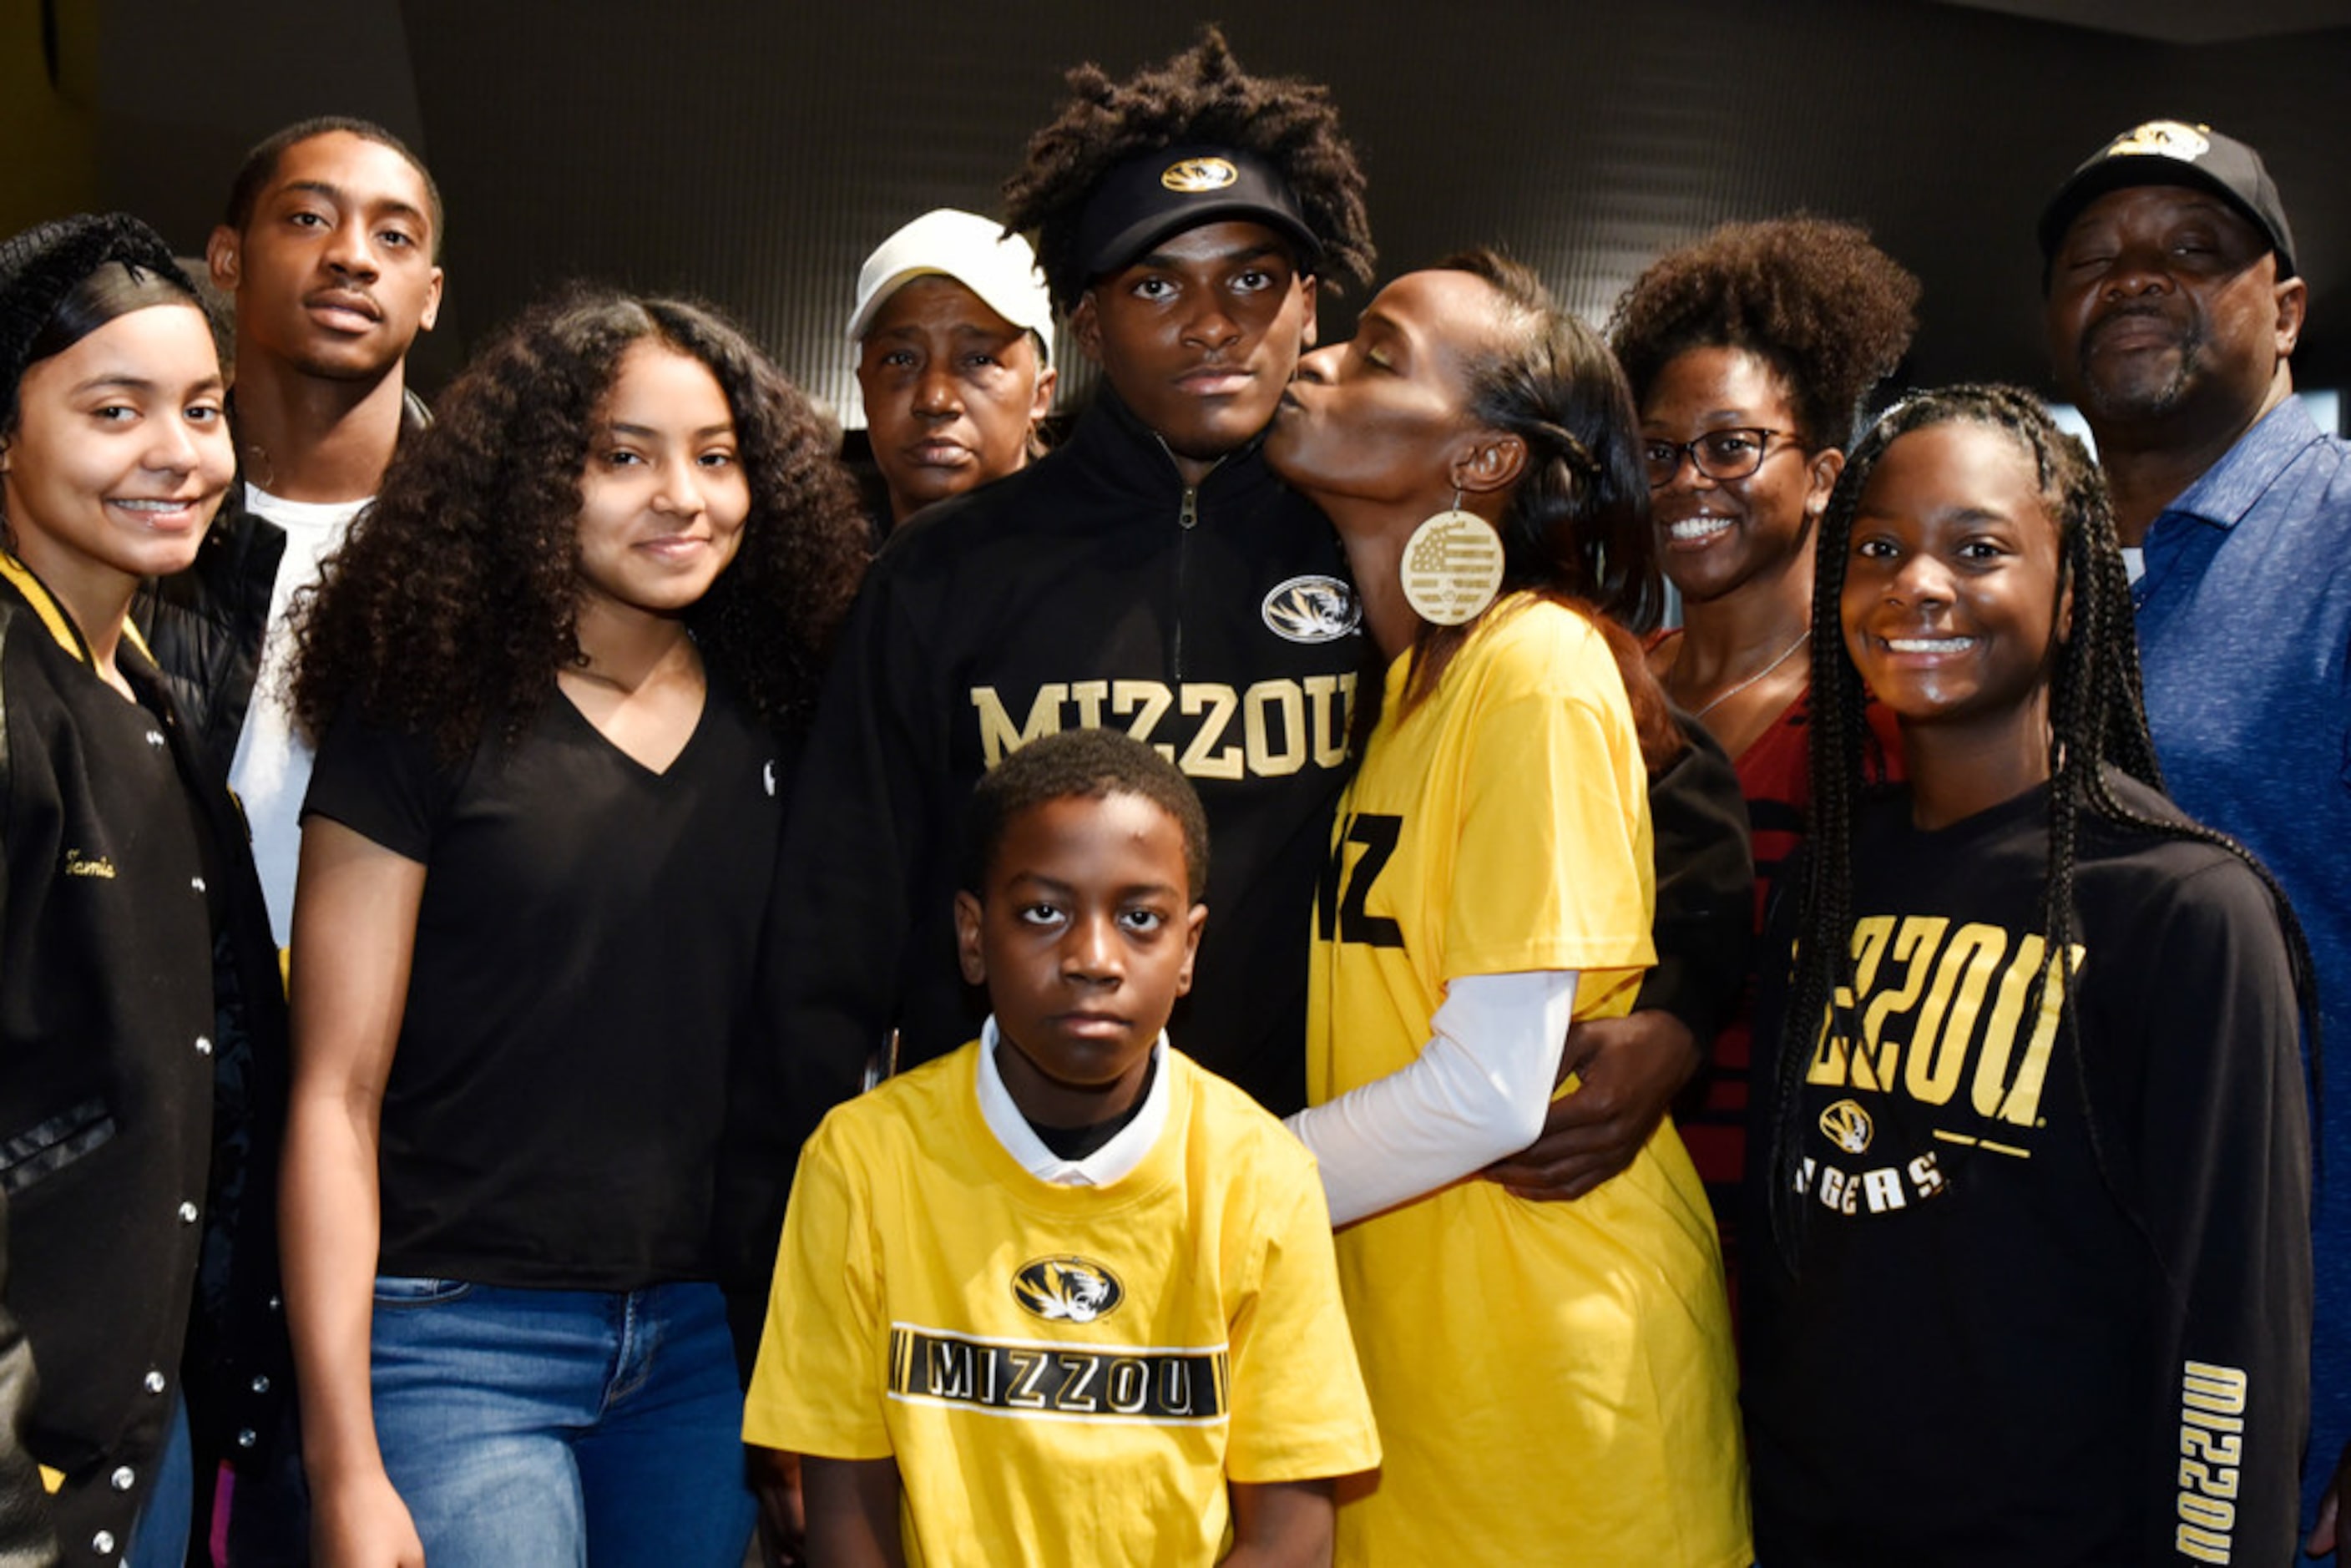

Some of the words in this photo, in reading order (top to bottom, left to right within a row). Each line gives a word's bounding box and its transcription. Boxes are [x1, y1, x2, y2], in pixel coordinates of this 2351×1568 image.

[970, 671, 1358, 780] MIZZOU
[926, 1339, 1193, 1415] MIZZOU
[2176, 1359, 2247, 1565] MIZZOU
